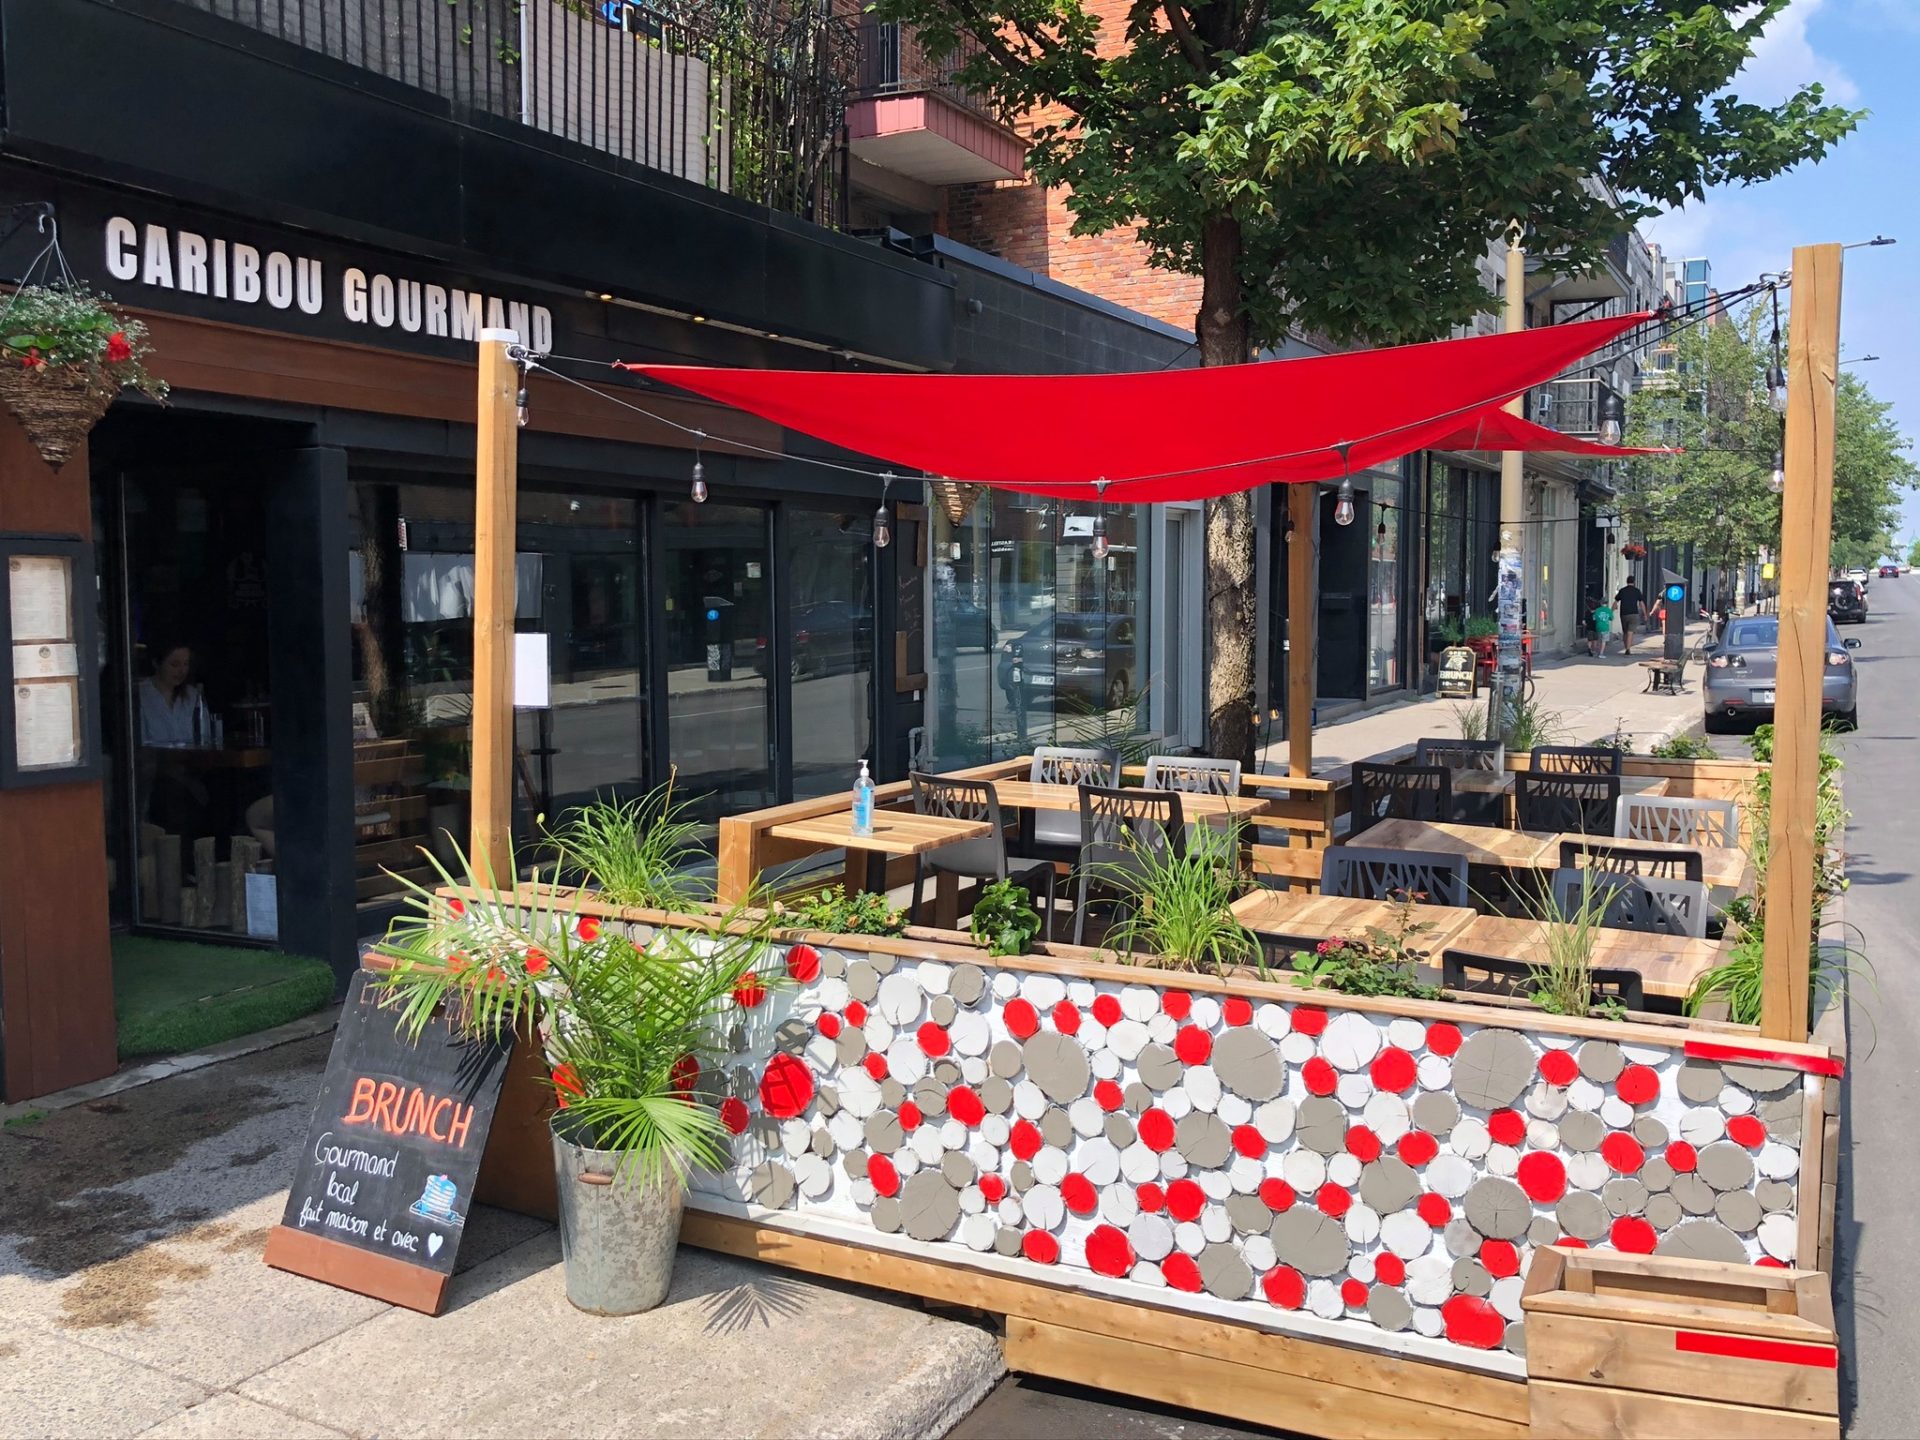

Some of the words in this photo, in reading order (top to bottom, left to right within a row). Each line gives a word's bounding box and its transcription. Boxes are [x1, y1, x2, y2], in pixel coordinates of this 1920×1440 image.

[105, 216, 323, 315] CARIBOU
[342, 267, 553, 354] GOURMAND
[1439, 670, 1473, 680] BRUNCH
[341, 1077, 475, 1148] BRUNCH
[314, 1131, 400, 1179] Gourmand
[326, 1171, 360, 1206] local
[298, 1196, 324, 1228] fait
[325, 1208, 369, 1237] maison
[373, 1219, 388, 1242] et
[391, 1230, 420, 1252] avec
